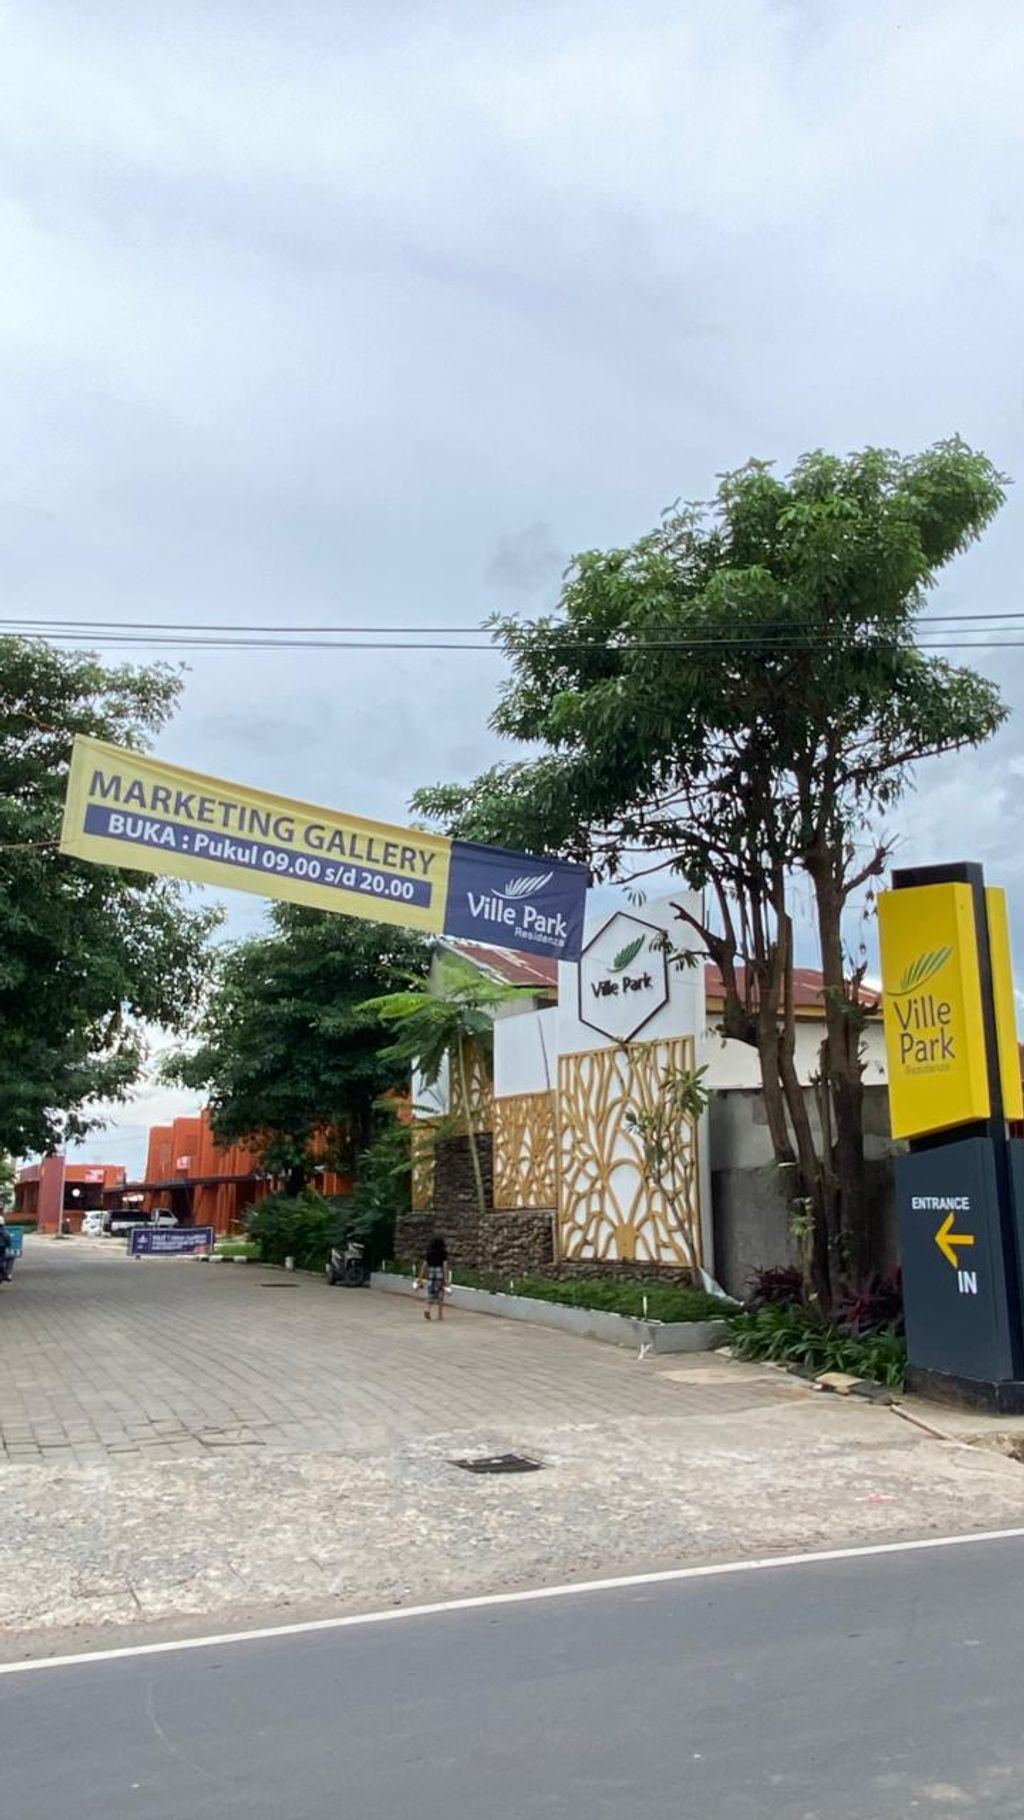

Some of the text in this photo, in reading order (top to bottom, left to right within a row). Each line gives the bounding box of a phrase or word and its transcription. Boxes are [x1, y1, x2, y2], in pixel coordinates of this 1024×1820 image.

[89, 770, 436, 875] MARKETING GALLERY
[107, 813, 415, 900] BUKA : Pukul 09.00 s/d 20.00
[467, 893, 568, 939] Ville Park
[591, 972, 653, 998] Ville Park
[893, 995, 951, 1030] Ville
[900, 1028, 955, 1064] Park
[911, 1196, 970, 1211] ENTRANCE
[957, 1270, 978, 1295] IN
